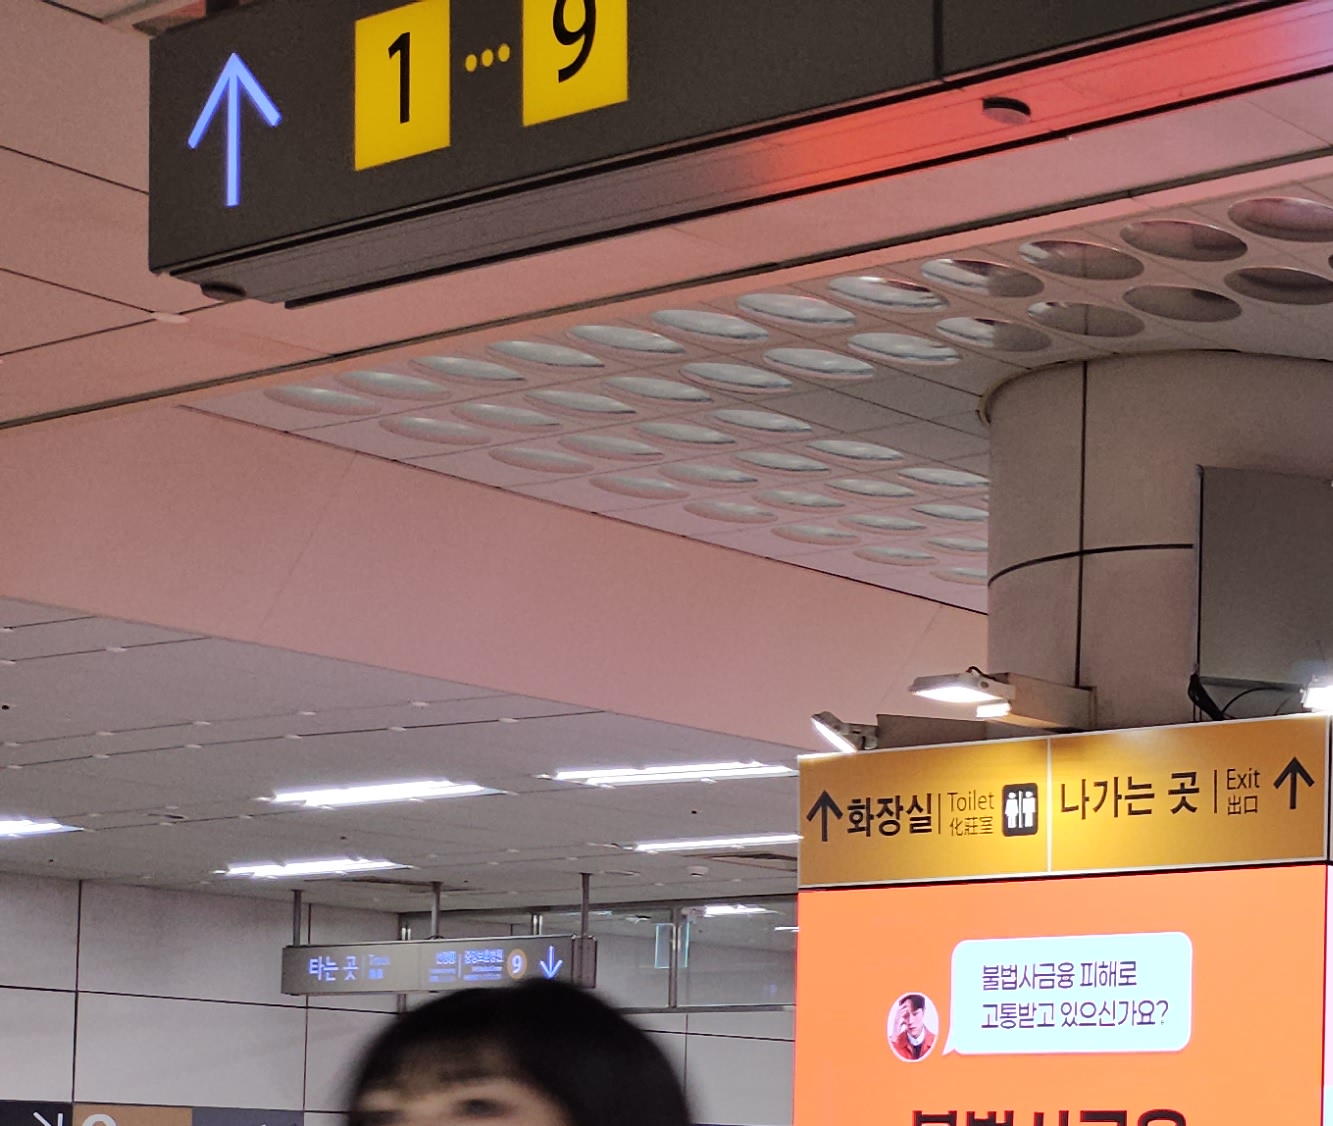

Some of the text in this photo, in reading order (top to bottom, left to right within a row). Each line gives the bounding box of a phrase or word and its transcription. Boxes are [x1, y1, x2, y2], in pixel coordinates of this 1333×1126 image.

[388, 31, 410, 124] 1
[552, 0, 597, 83] 9
[1226, 768, 1260, 791] Exit
[947, 790, 994, 812] Toilet
[1060, 771, 1201, 820] 나가는 곳
[1227, 796, 1259, 816] 出口
[847, 791, 933, 839] 화장실
[308, 955, 339, 981] 타는
[342, 955, 359, 981] 곳
[511, 955, 522, 974] 9
[981, 960, 1138, 991] 불법사금융 피해로
[980, 999, 1170, 1030] 고통받고 있으신가요?
